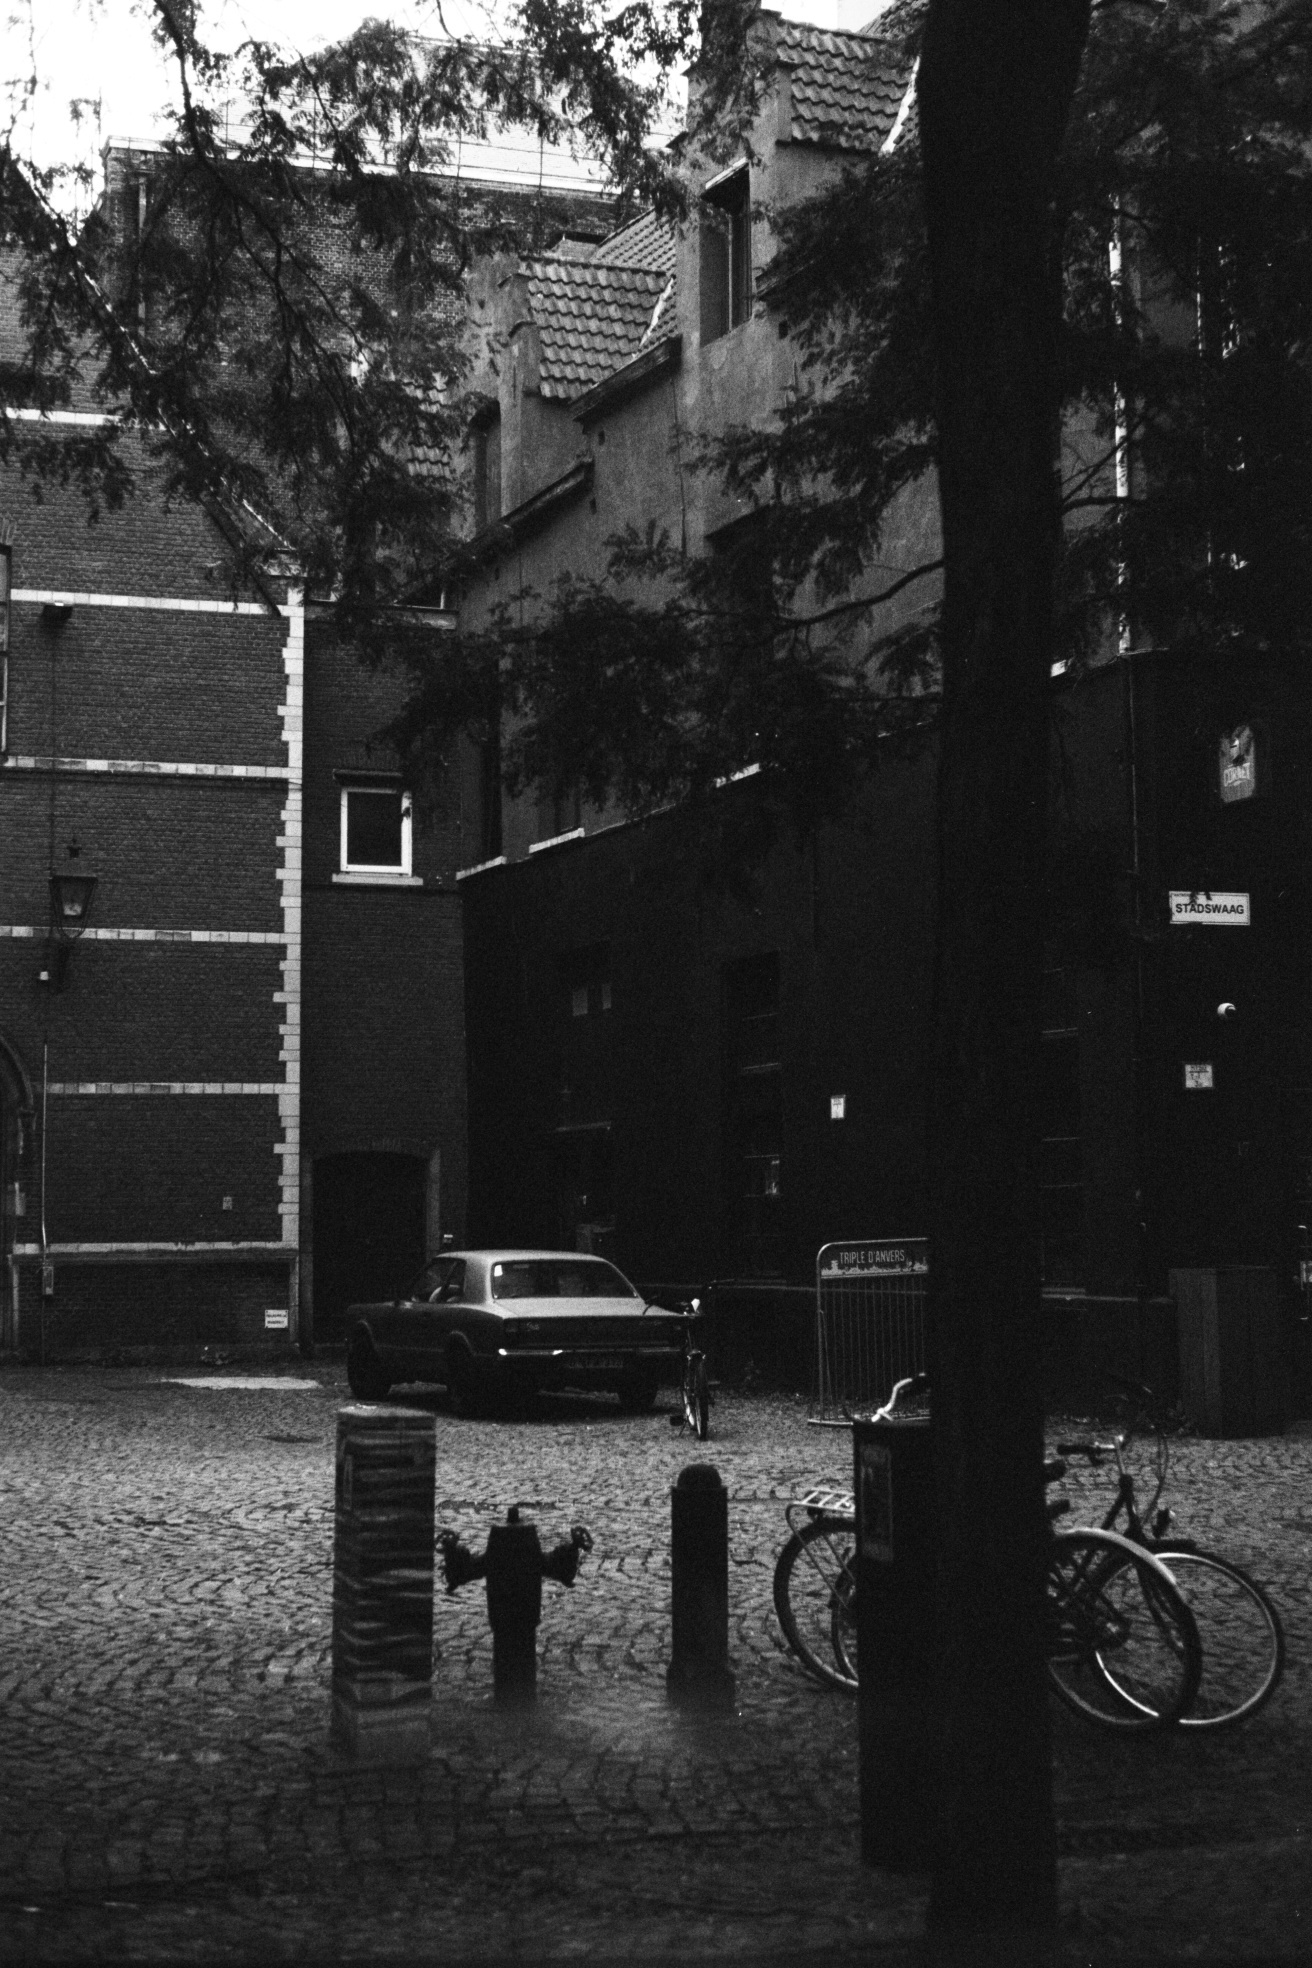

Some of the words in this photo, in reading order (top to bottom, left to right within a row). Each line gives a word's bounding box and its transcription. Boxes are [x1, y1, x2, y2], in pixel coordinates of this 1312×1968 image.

[1175, 903, 1245, 915] STADSWAAG
[839, 1251, 865, 1265] TRIPLE
[868, 1249, 905, 1263] D'ANVERS
